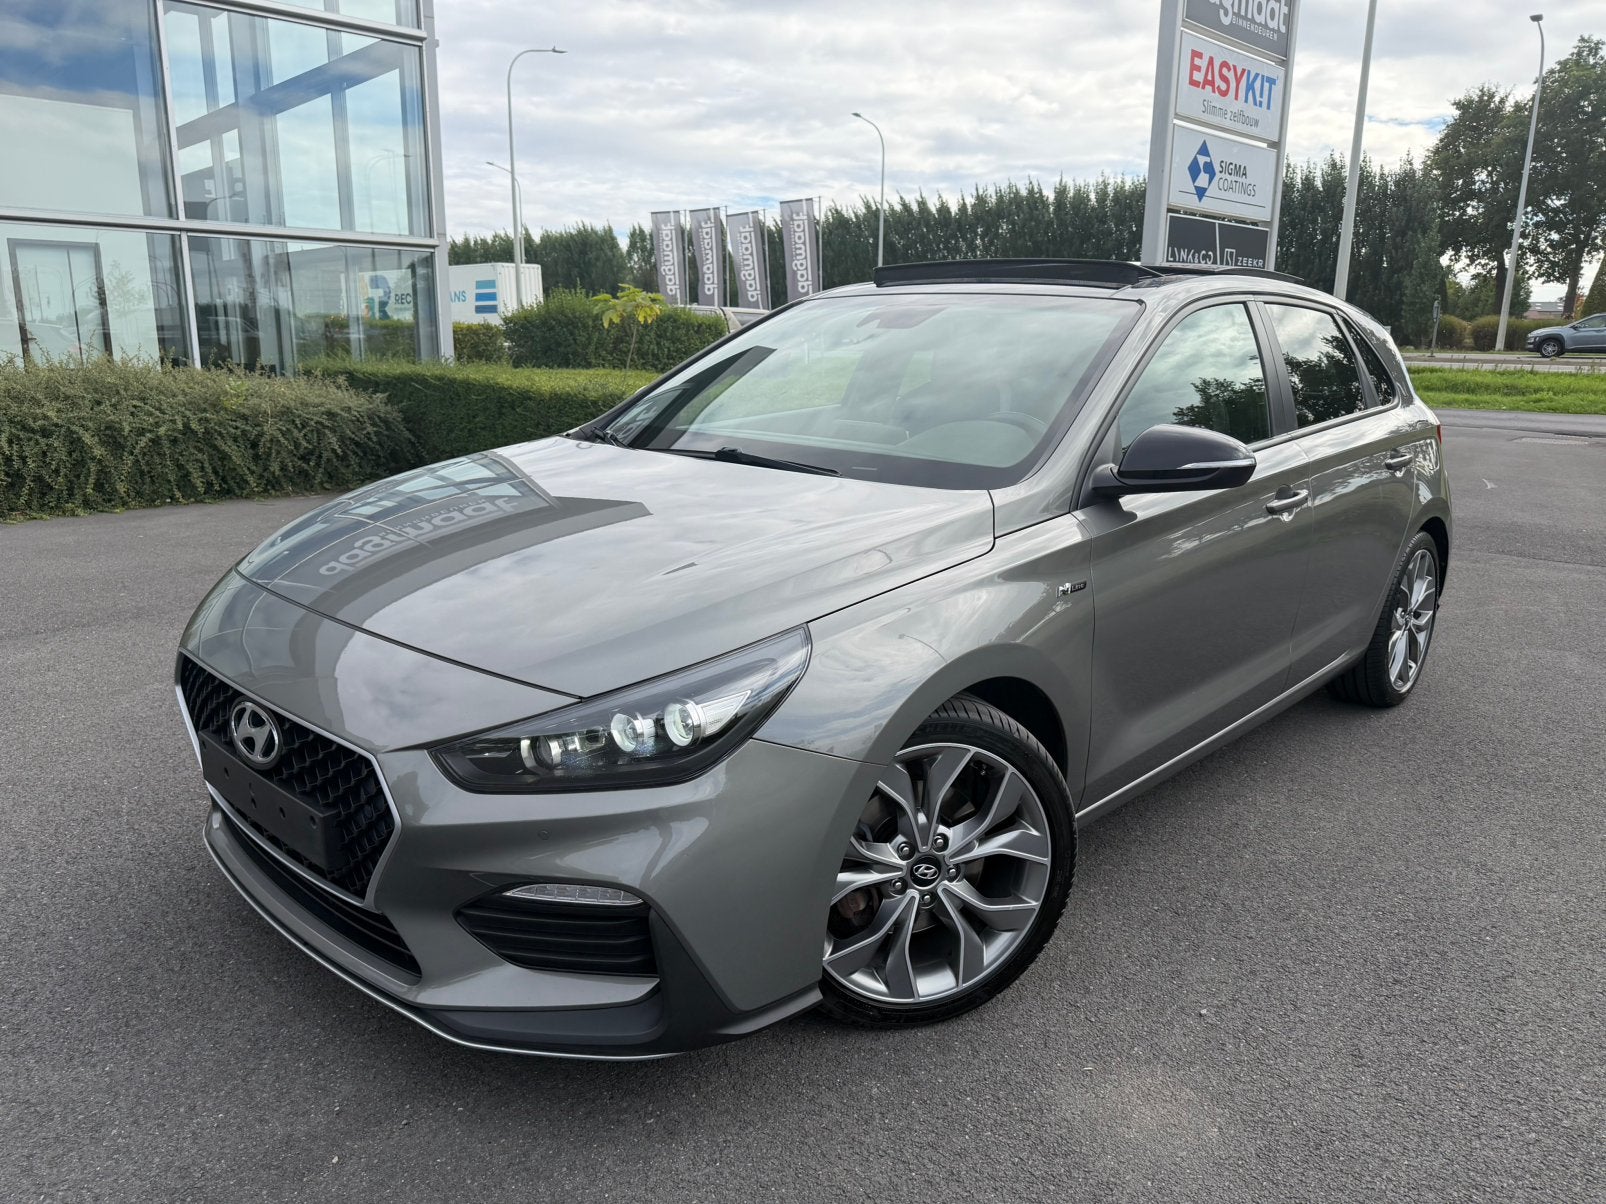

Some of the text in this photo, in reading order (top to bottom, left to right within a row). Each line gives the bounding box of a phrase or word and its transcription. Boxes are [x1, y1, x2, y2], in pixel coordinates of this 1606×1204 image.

[1201, 98, 1260, 128] Slimme zelfbouw
[1219, 160, 1247, 179] SIGMA
[1217, 177, 1256, 197] COATINGS
[1237, 256, 1264, 268] ZEEKR
